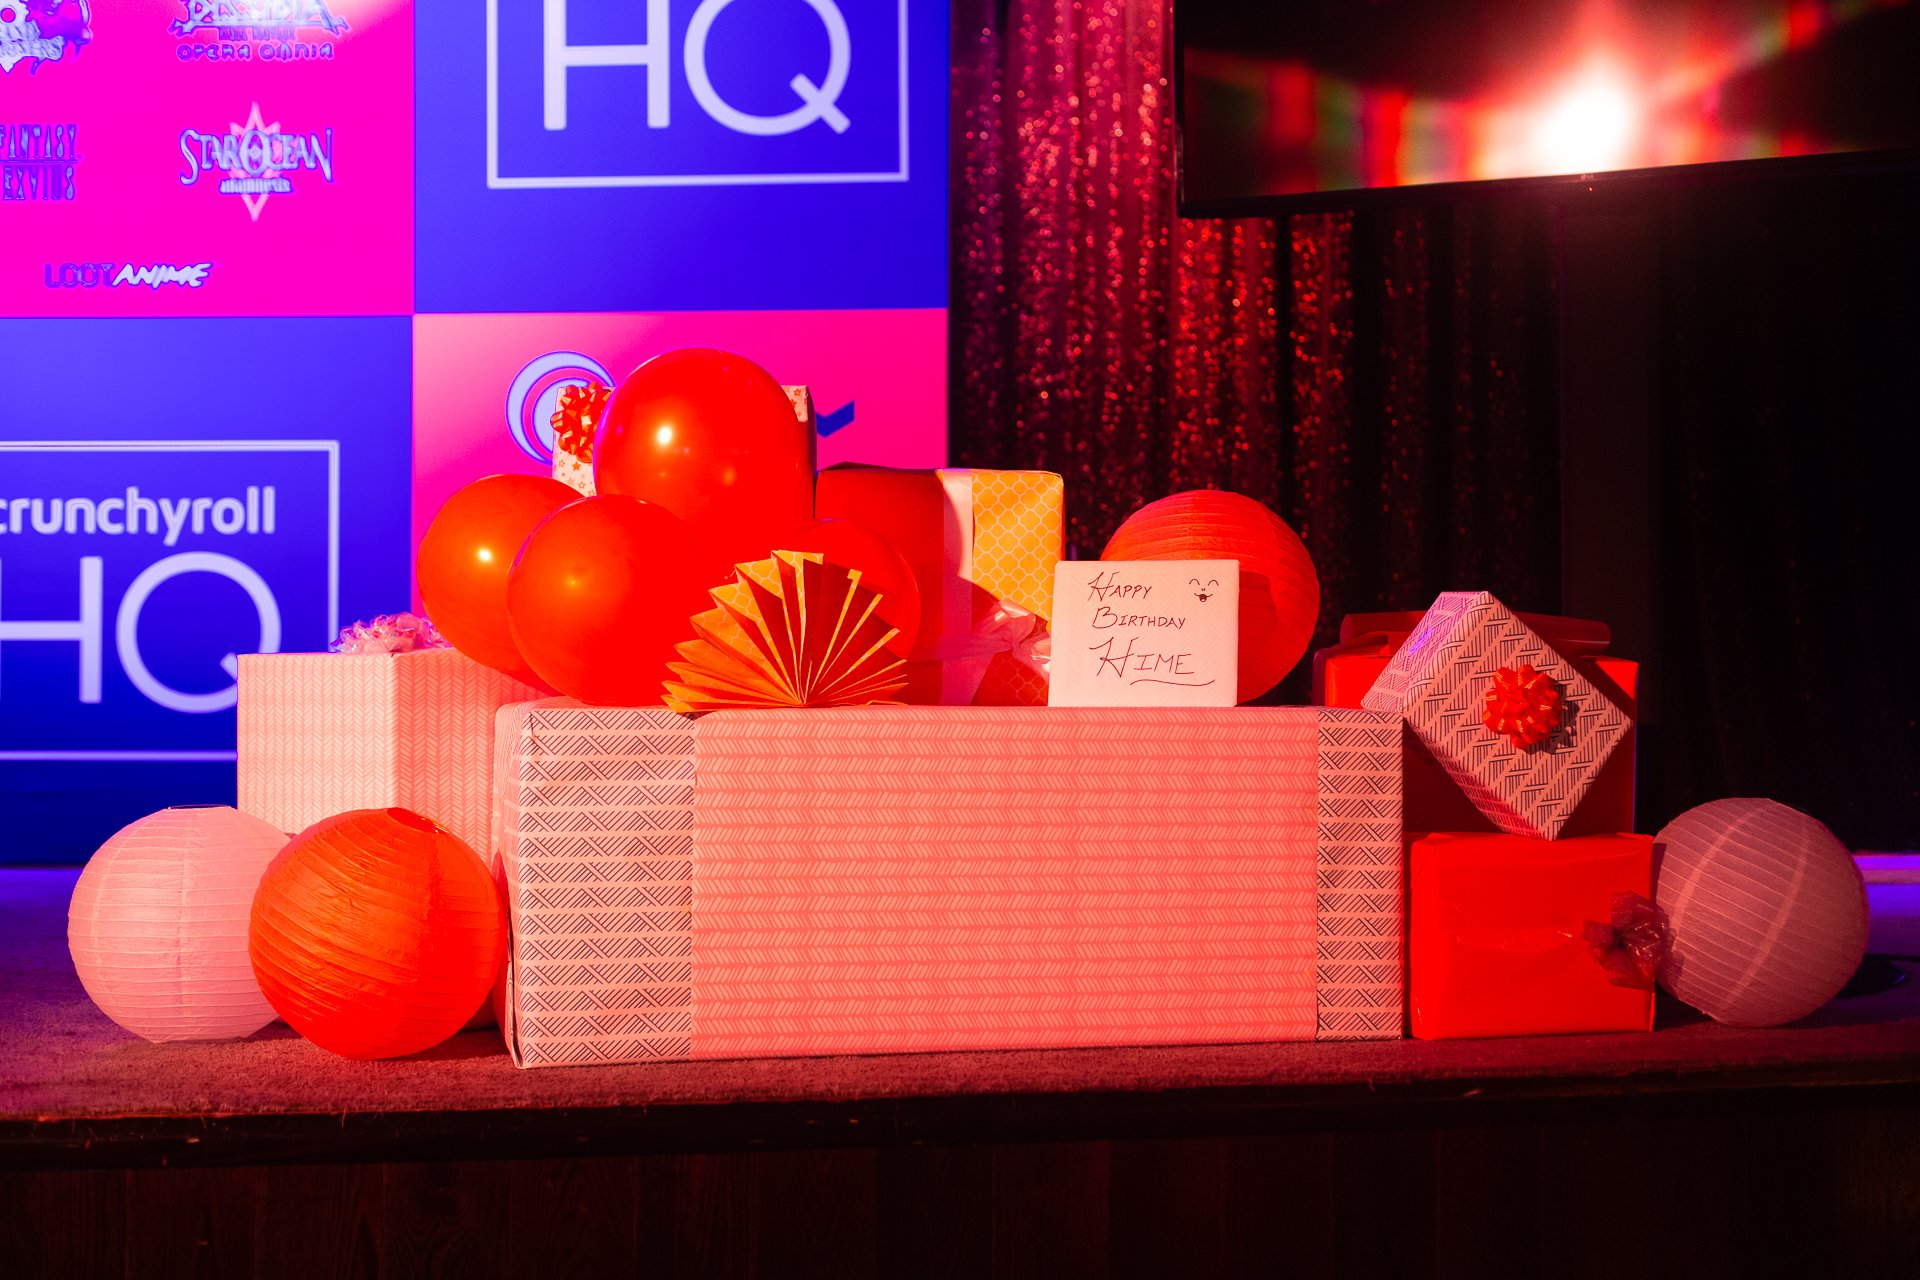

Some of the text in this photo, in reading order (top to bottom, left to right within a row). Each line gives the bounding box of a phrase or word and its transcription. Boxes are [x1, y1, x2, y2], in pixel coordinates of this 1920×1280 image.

[176, 43, 251, 62] OPERA
[543, 0, 852, 136] HQ
[0, 486, 276, 547] runchyroll
[1087, 571, 1153, 602] HAPPY
[0, 551, 282, 714] HQ
[1091, 606, 1186, 630] BIRTHDAY
[1088, 636, 1195, 678] HIME
